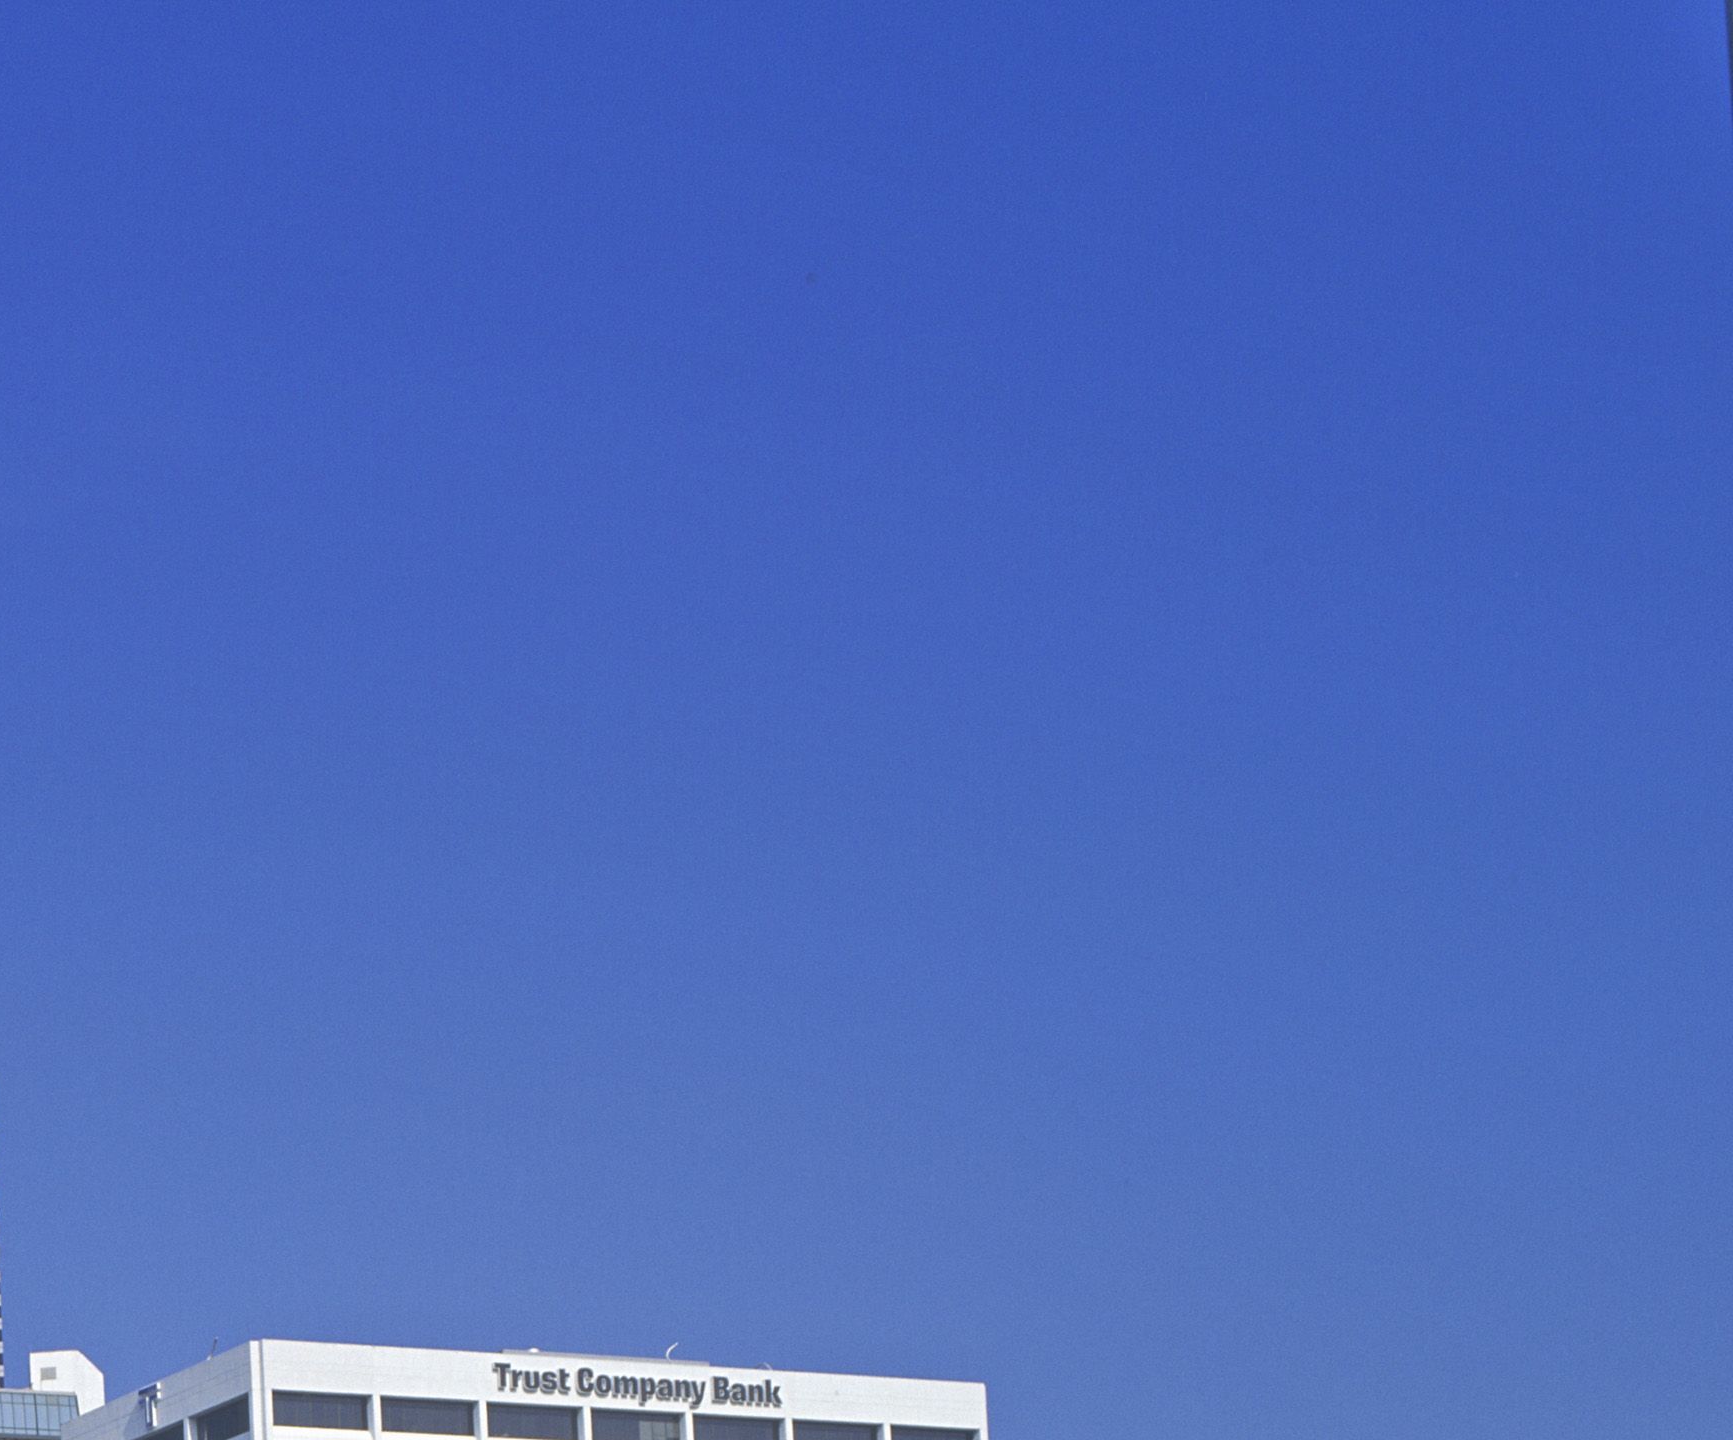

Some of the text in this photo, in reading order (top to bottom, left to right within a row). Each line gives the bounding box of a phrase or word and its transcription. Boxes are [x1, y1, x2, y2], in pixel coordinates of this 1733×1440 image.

[492, 1361, 783, 1409] Trust Company Bank
